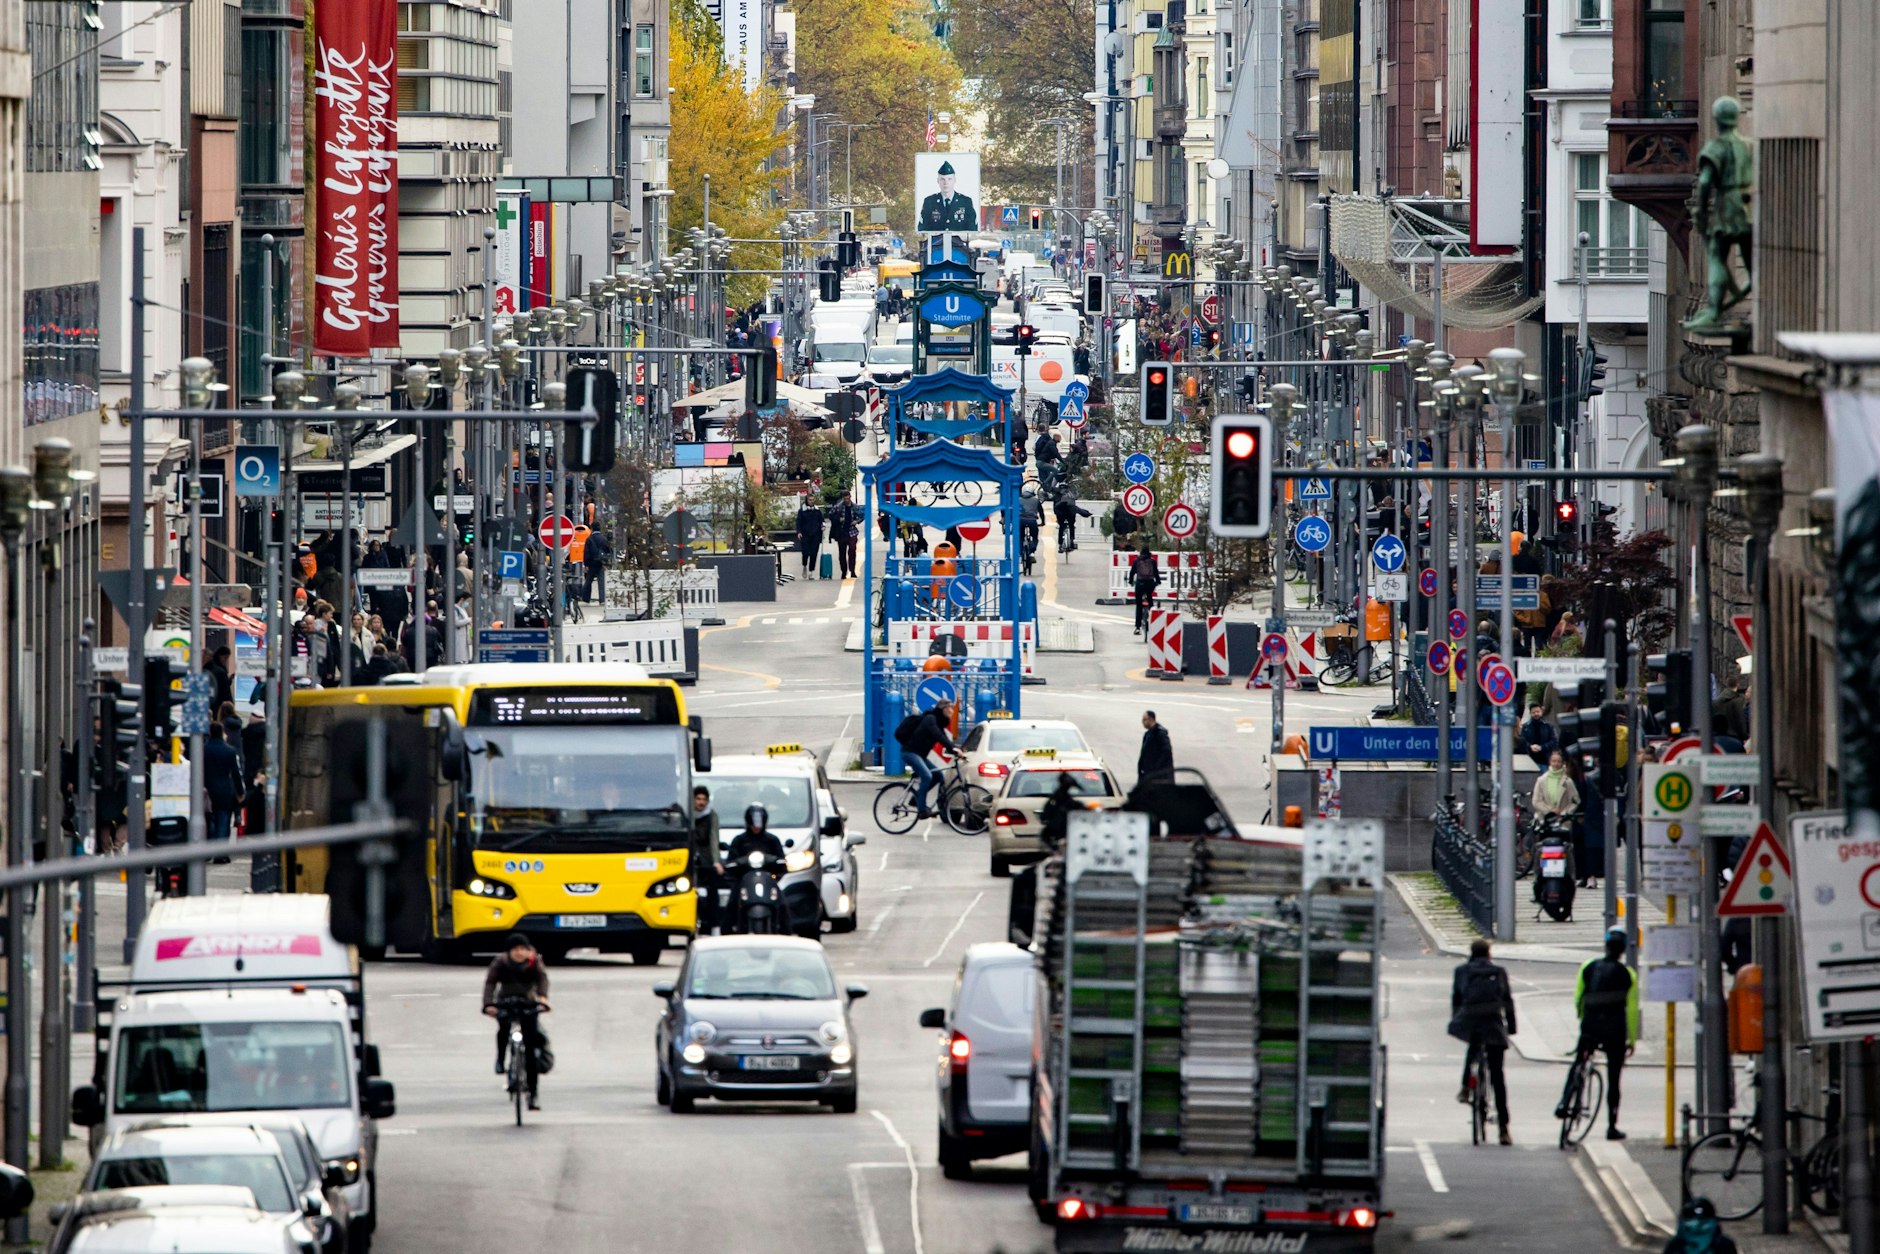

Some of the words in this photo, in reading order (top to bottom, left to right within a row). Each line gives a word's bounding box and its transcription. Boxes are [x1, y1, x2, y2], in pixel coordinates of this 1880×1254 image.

[740, 2, 747, 19] AM
[314, 36, 370, 196] Lafayette
[536, 222, 544, 256] Reisebüro
[315, 204, 369, 331] Galeries
[945, 296, 960, 313] U
[933, 314, 972, 322] Stadtmitte
[1131, 494, 1147, 506] 20
[1171, 514, 1188, 528] 20
[503, 555, 518, 575] P
[1526, 664, 1553, 674] Unter
[1554, 664, 1572, 674] den
[1316, 732, 1333, 753] U
[1363, 735, 1401, 750] Unter
[1405, 735, 1431, 750] den
[1666, 782, 1683, 802] H
